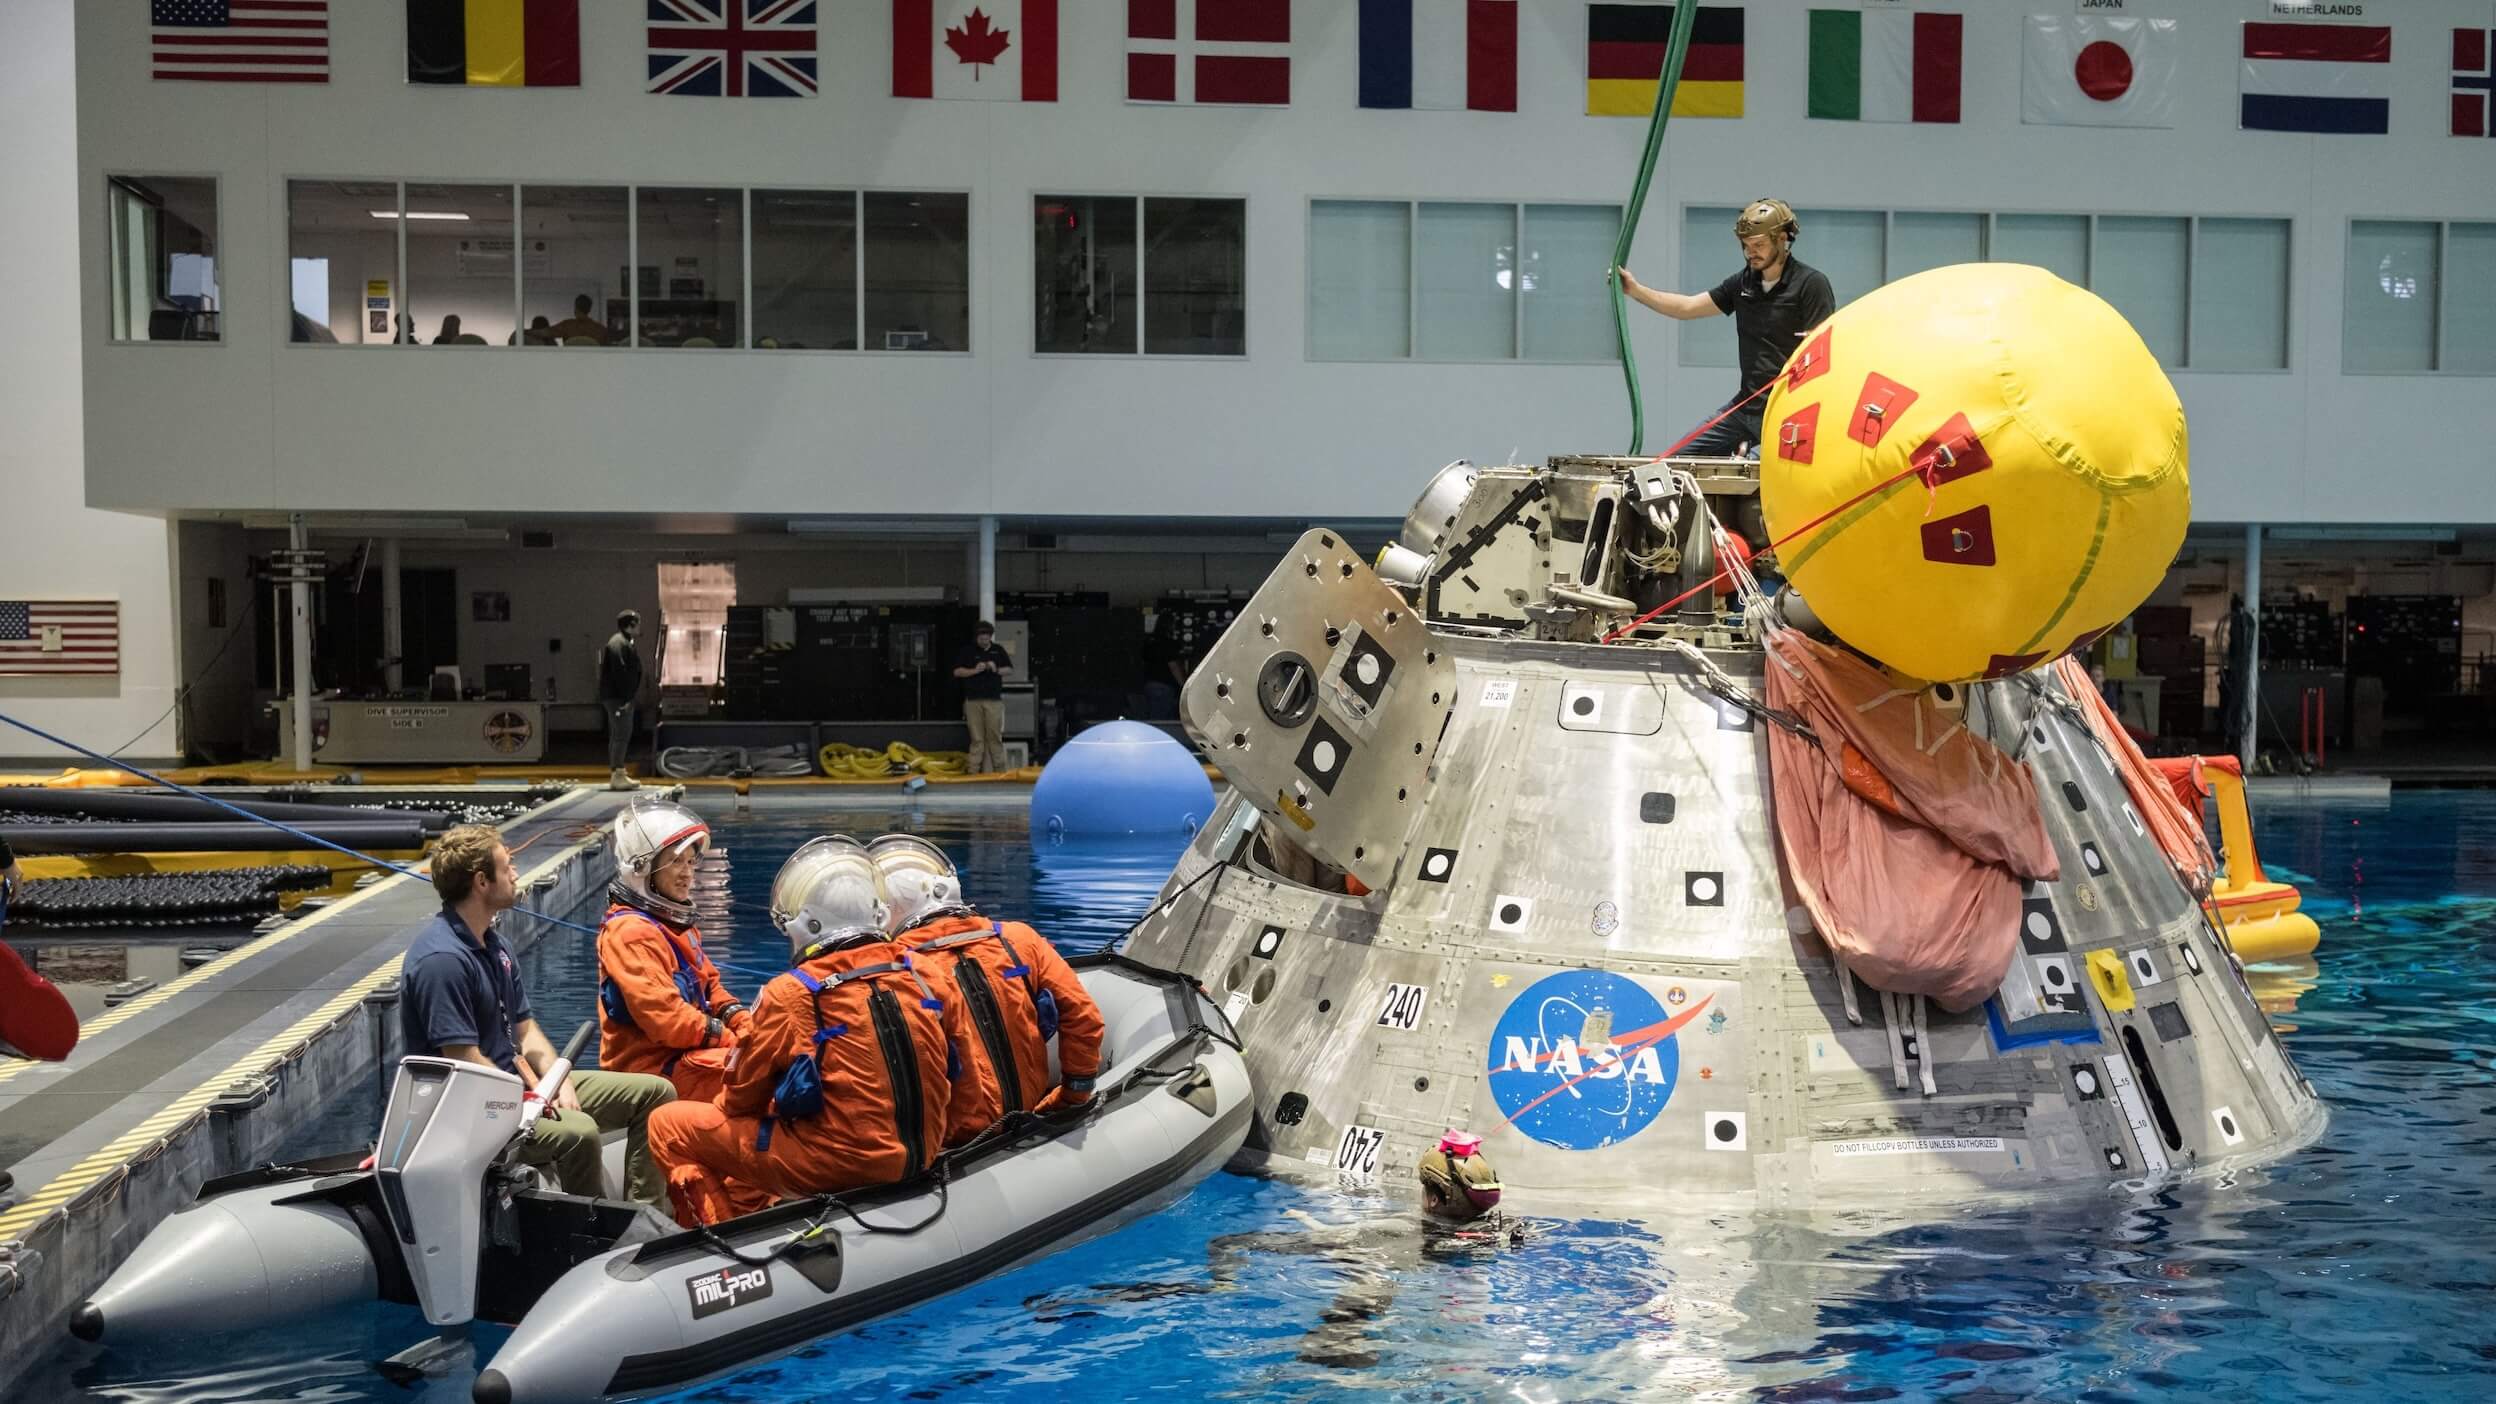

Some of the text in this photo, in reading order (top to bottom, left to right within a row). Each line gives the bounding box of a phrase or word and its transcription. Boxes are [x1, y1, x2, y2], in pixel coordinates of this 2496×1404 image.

[2082, 0, 2122, 8] JAPAN
[2273, 3, 2363, 15] NETHERLANDS
[367, 707, 448, 716] DIVE SUPERVISOR
[393, 720, 413, 728] SIDE
[1377, 984, 1421, 1029] 240
[1502, 1034, 1666, 1085] NASA
[484, 1101, 518, 1110] MERCURY
[1339, 1126, 1385, 1173] 240
[1834, 1144, 1845, 1153] DO
[1846, 1143, 1861, 1152] NOT
[1897, 1141, 1928, 1150] BOTTLES
[1929, 1140, 1956, 1149] UNLESS
[1957, 1139, 1998, 1149] AUTHORIZED
[692, 1273, 722, 1288] ZODIAC
